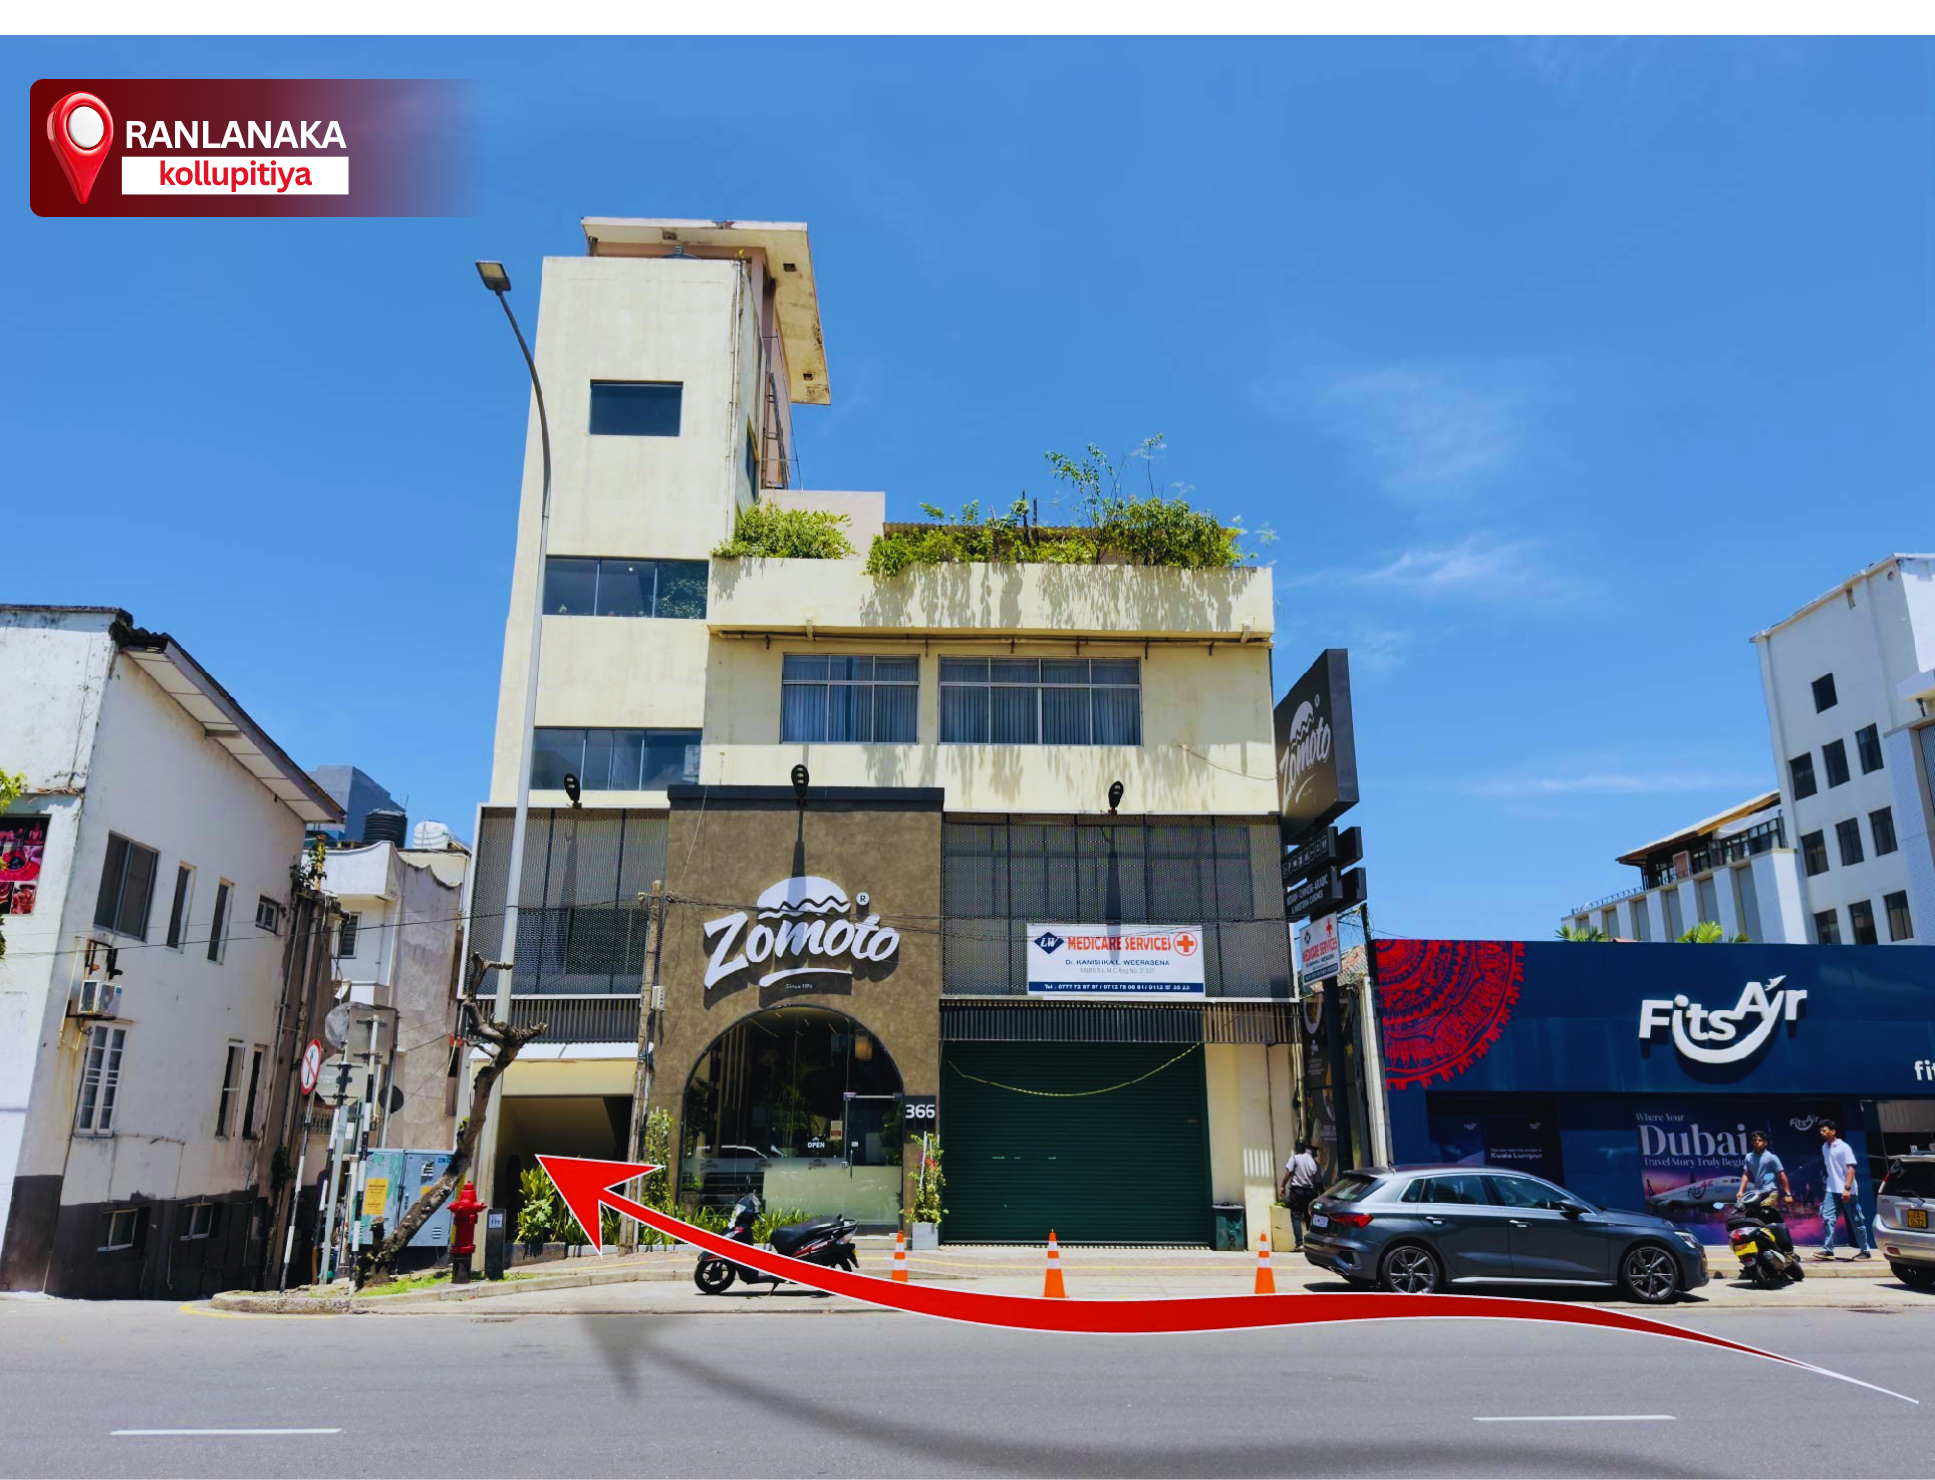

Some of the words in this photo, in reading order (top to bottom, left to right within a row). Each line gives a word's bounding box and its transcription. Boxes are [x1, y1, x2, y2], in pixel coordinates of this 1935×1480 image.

[1067, 936, 1122, 951] MEDICARE
[1125, 936, 1171, 951] SERVICES
[703, 912, 900, 990] Zomoto
[905, 1103, 936, 1120] 366
[1636, 1113, 1663, 1122] Where
[1665, 1113, 1685, 1122] Your
[807, 1141, 826, 1149] OPEN
[1638, 1123, 1748, 1157] Dubai
[1513, 1152, 1543, 1160] Lumpur
[1643, 1157, 1671, 1167] Travel
[1671, 1157, 1696, 1168] Story
[1697, 1157, 1721, 1168] Truly
